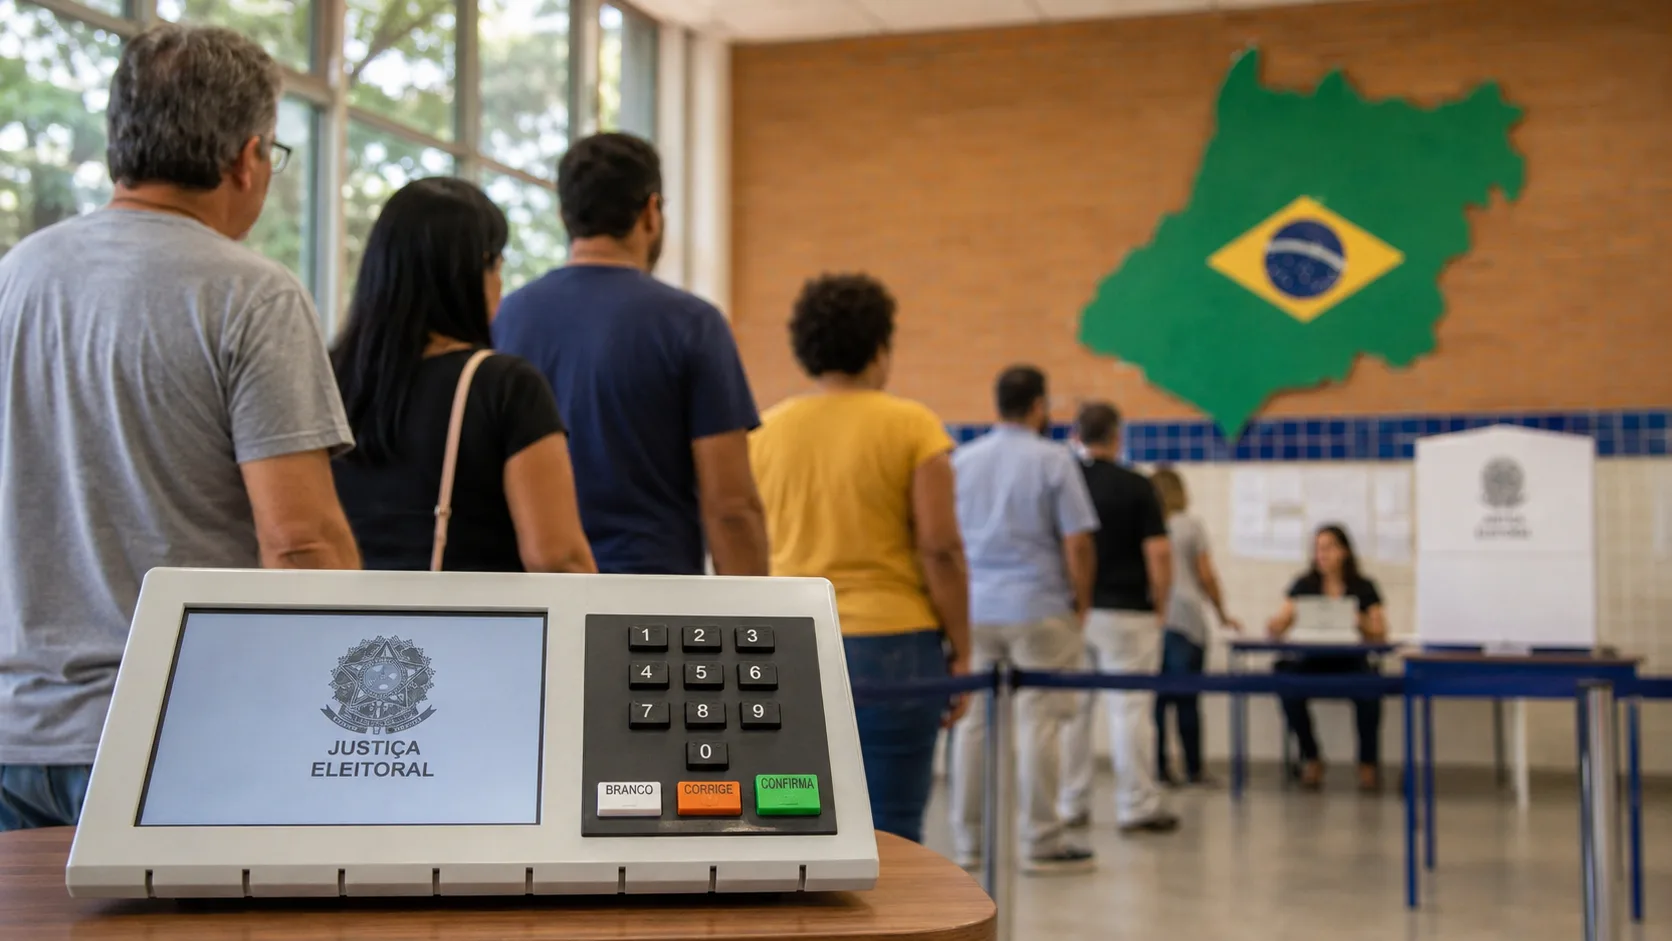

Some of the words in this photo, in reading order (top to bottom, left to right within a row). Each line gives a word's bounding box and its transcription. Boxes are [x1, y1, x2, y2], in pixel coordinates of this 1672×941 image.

[641, 628, 649, 642] 1
[693, 628, 705, 642] 2
[746, 628, 758, 642] 3
[640, 665, 653, 679] 4
[695, 665, 707, 679] 5
[749, 665, 761, 679] 6
[641, 703, 653, 718] 7
[697, 703, 709, 718] 8
[752, 703, 764, 718] 9
[327, 740, 421, 759] JUSTIÇA
[699, 743, 712, 759] 0
[311, 761, 434, 777] ELEITORAL
[605, 784, 654, 795] BRANCO
[684, 784, 733, 795] CORRIGE
[760, 777, 815, 790] CONFIRMA
